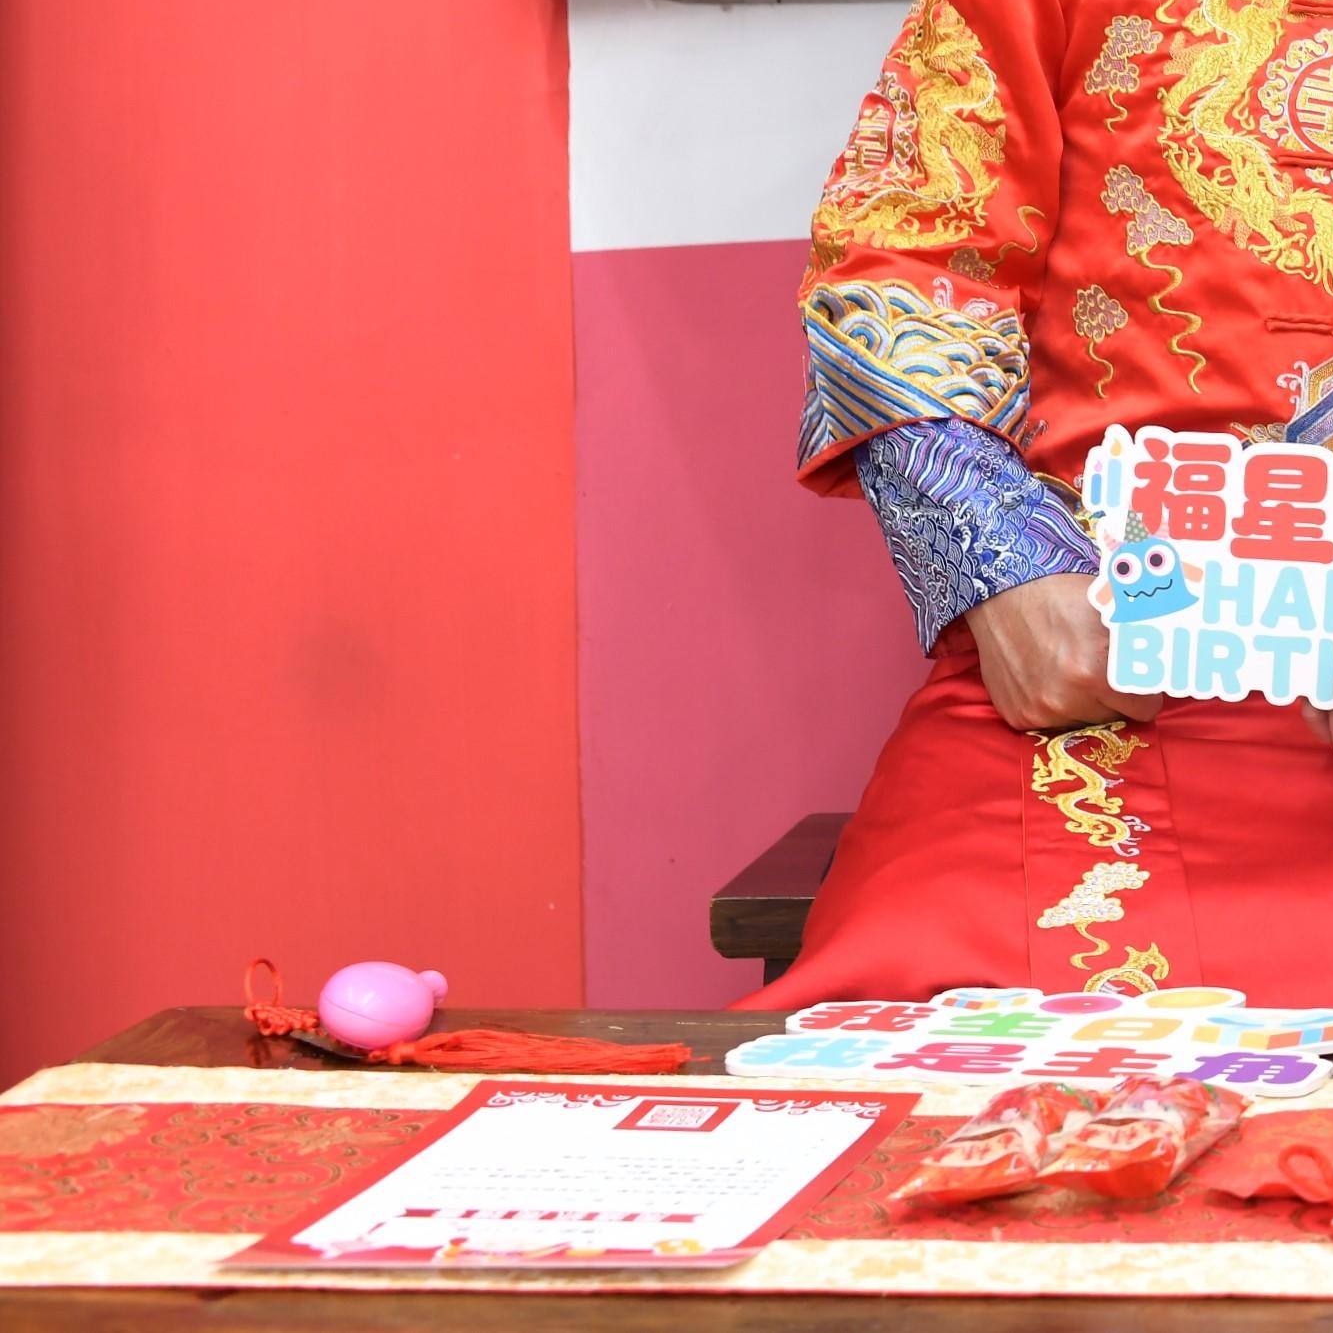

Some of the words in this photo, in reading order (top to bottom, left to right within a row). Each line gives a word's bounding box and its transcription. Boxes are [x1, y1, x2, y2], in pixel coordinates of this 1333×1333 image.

[798, 1004, 1184, 1043] 我生日
[738, 1034, 1332, 1084] 我是主角
